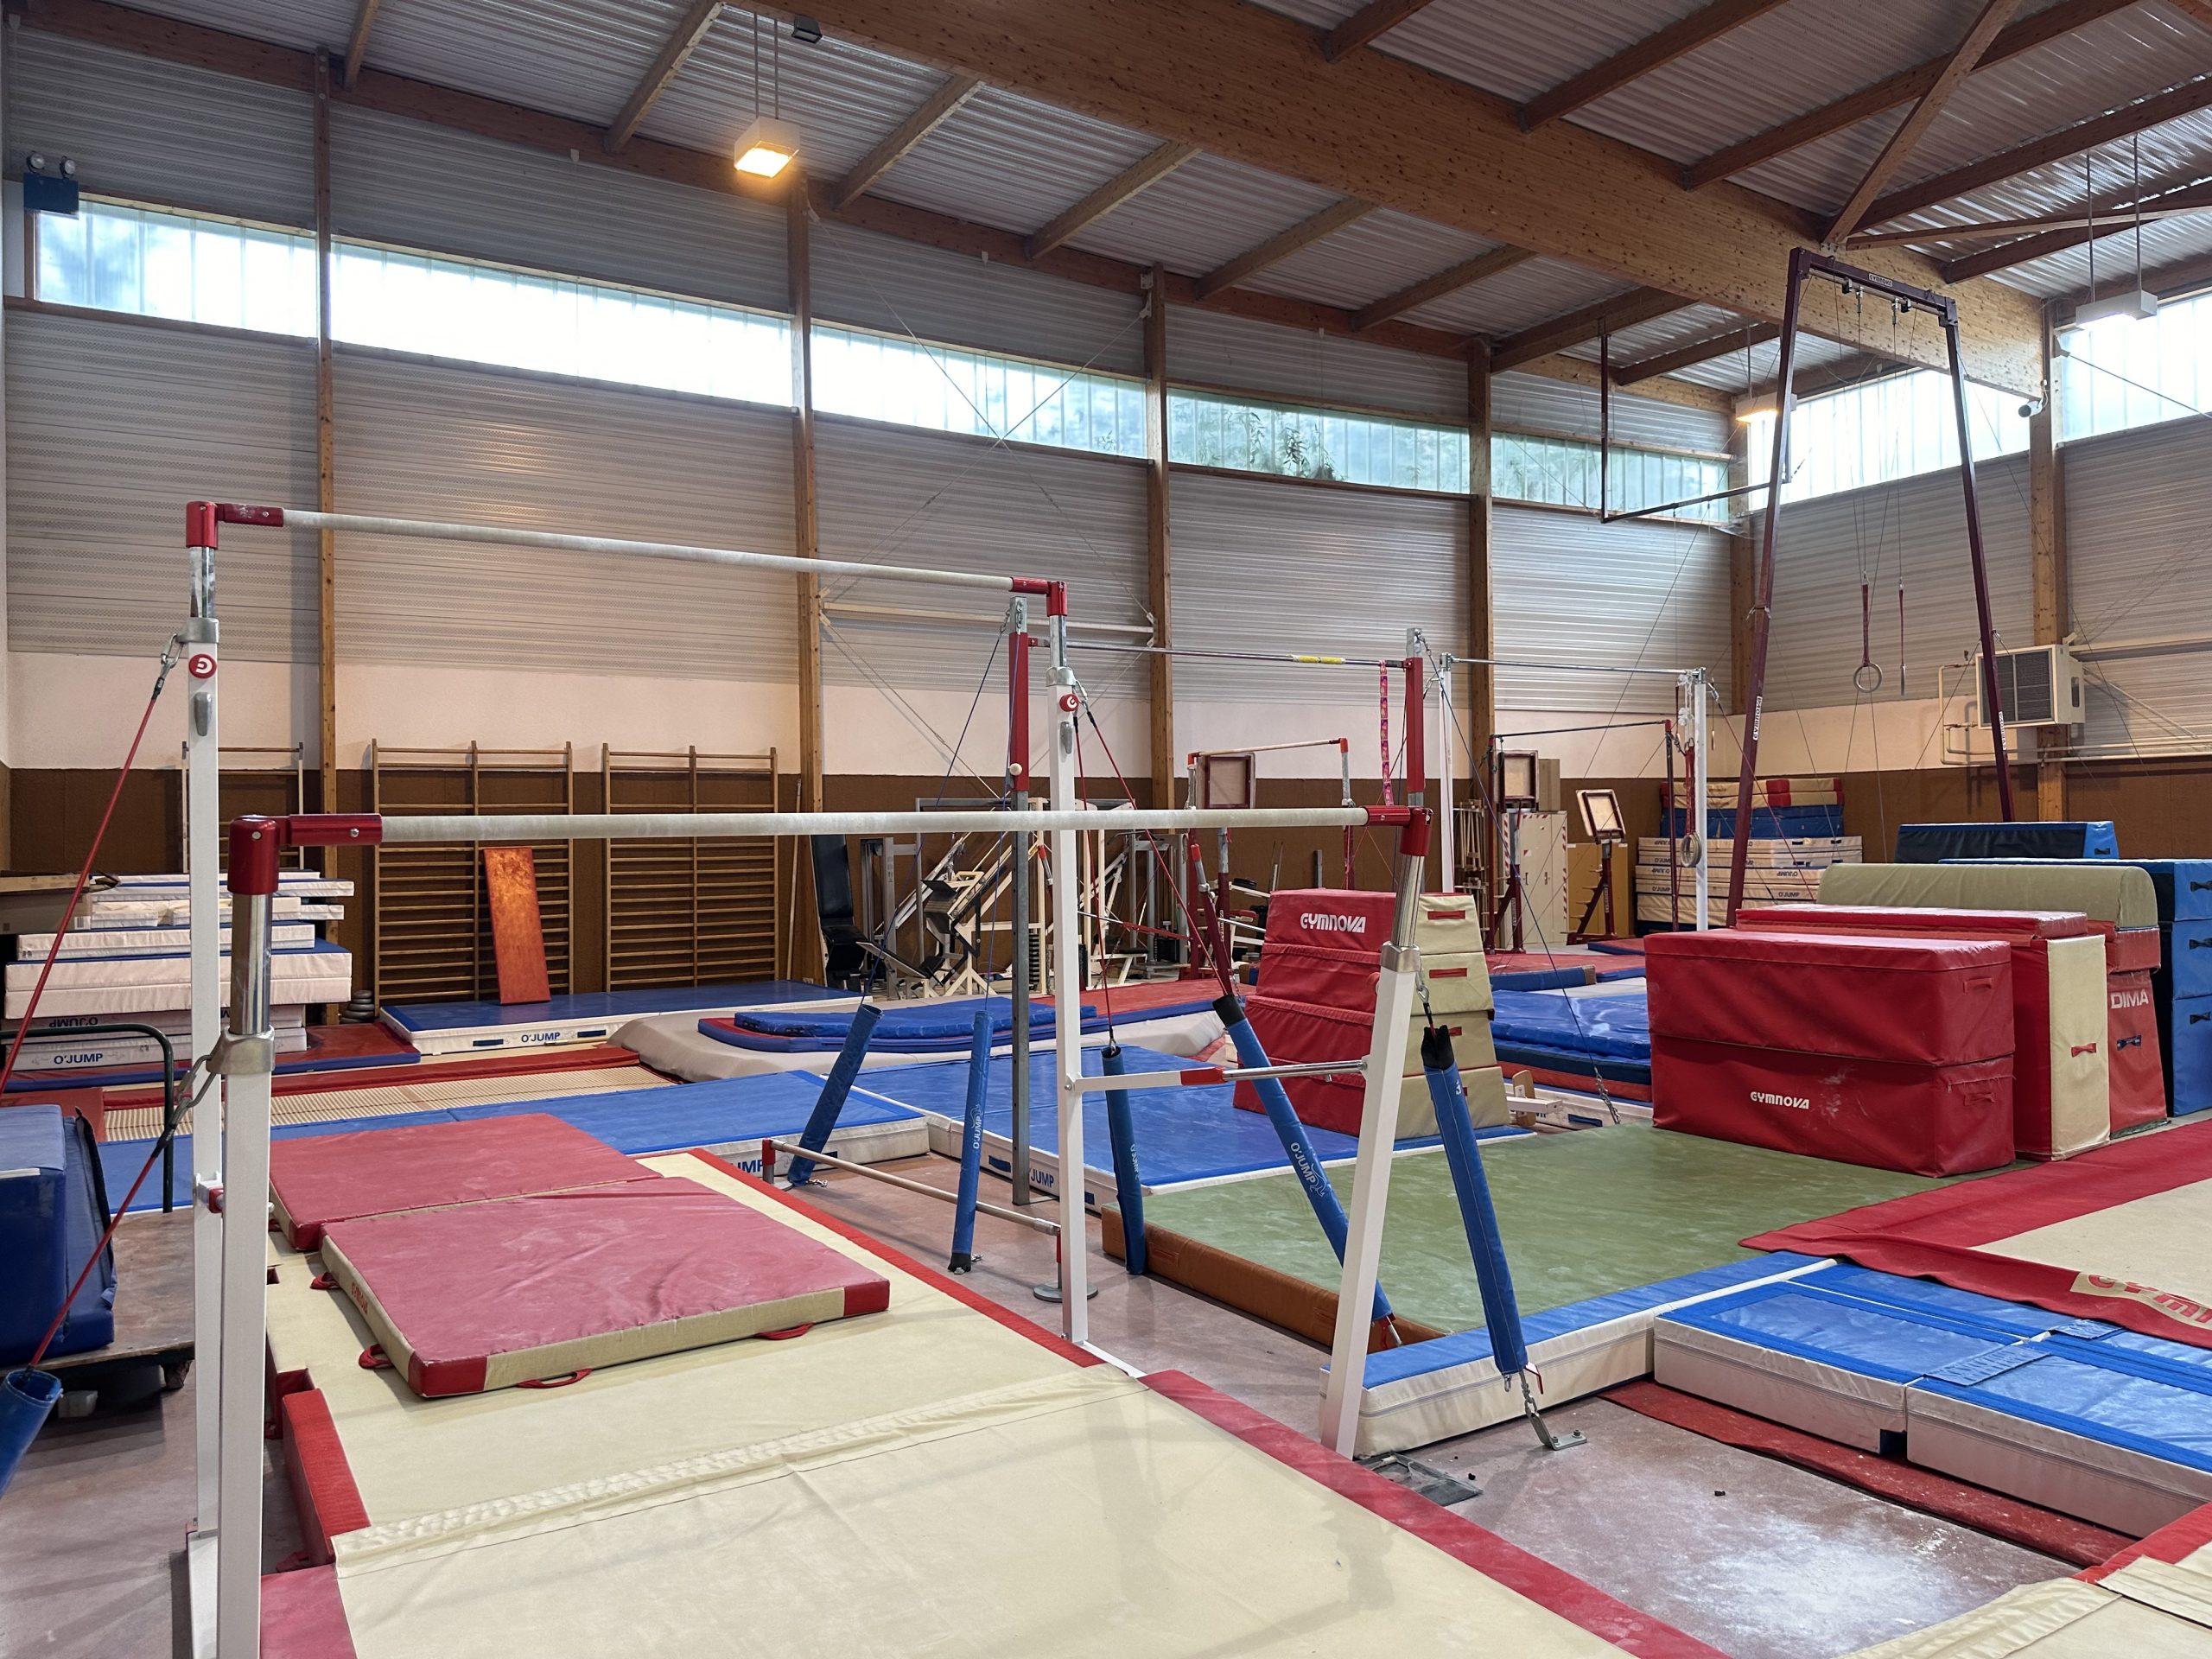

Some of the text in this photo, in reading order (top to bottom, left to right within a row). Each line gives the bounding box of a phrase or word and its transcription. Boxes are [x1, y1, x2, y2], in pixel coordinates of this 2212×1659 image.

[1753, 696, 1762, 739] GYMNOVA
[1300, 912, 1366, 934] GYMNOVA
[2110, 988, 2149, 1009] DIMA
[49, 1016, 99, 1028] O'JUMP
[521, 1032, 561, 1043] O'JUMP
[54, 1052, 103, 1065] O'JUMP
[1750, 1090, 1810, 1109] GYMNOVA
[972, 1116, 983, 1150] O'JUMP
[1290, 1142, 1316, 1184] O'JUMP
[1029, 1168, 1054, 1189] JUMP
